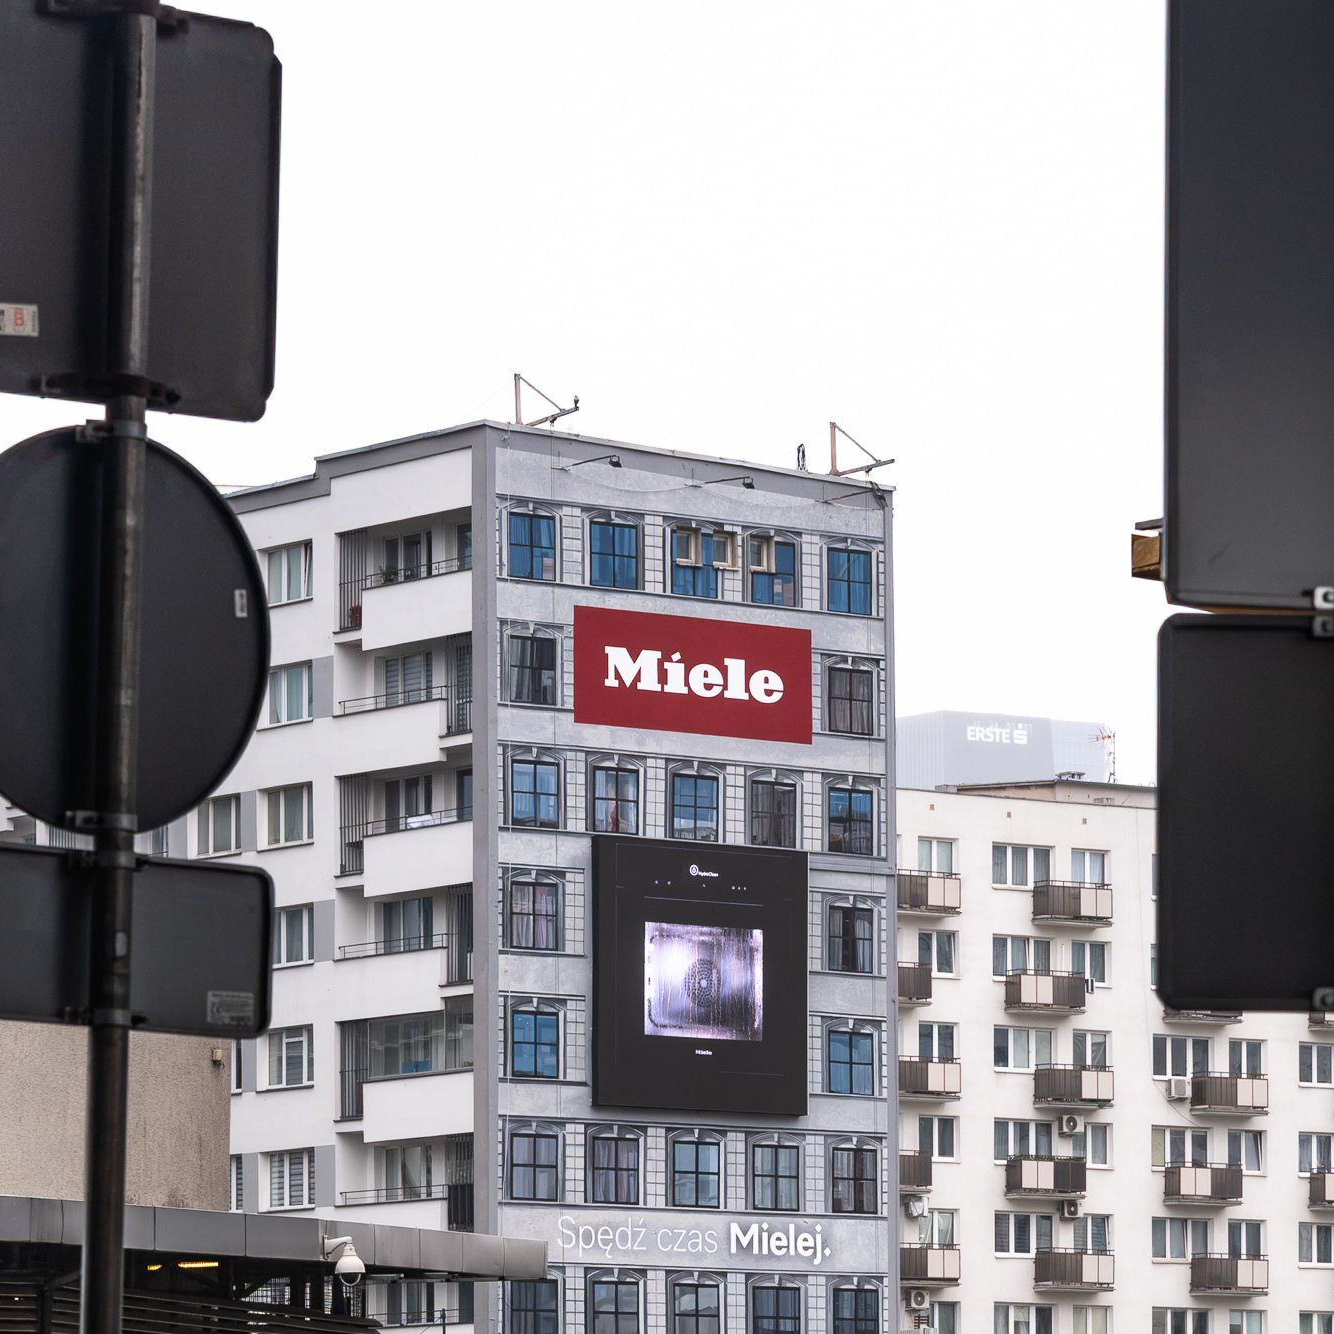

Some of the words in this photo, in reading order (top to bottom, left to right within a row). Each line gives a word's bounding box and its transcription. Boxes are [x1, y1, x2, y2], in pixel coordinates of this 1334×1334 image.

[604, 645, 785, 704] Miele
[967, 725, 1010, 744] ERSTE
[557, 1216, 646, 1258] Spędź
[657, 1227, 718, 1253] czas
[730, 1222, 832, 1265] Mielej.
